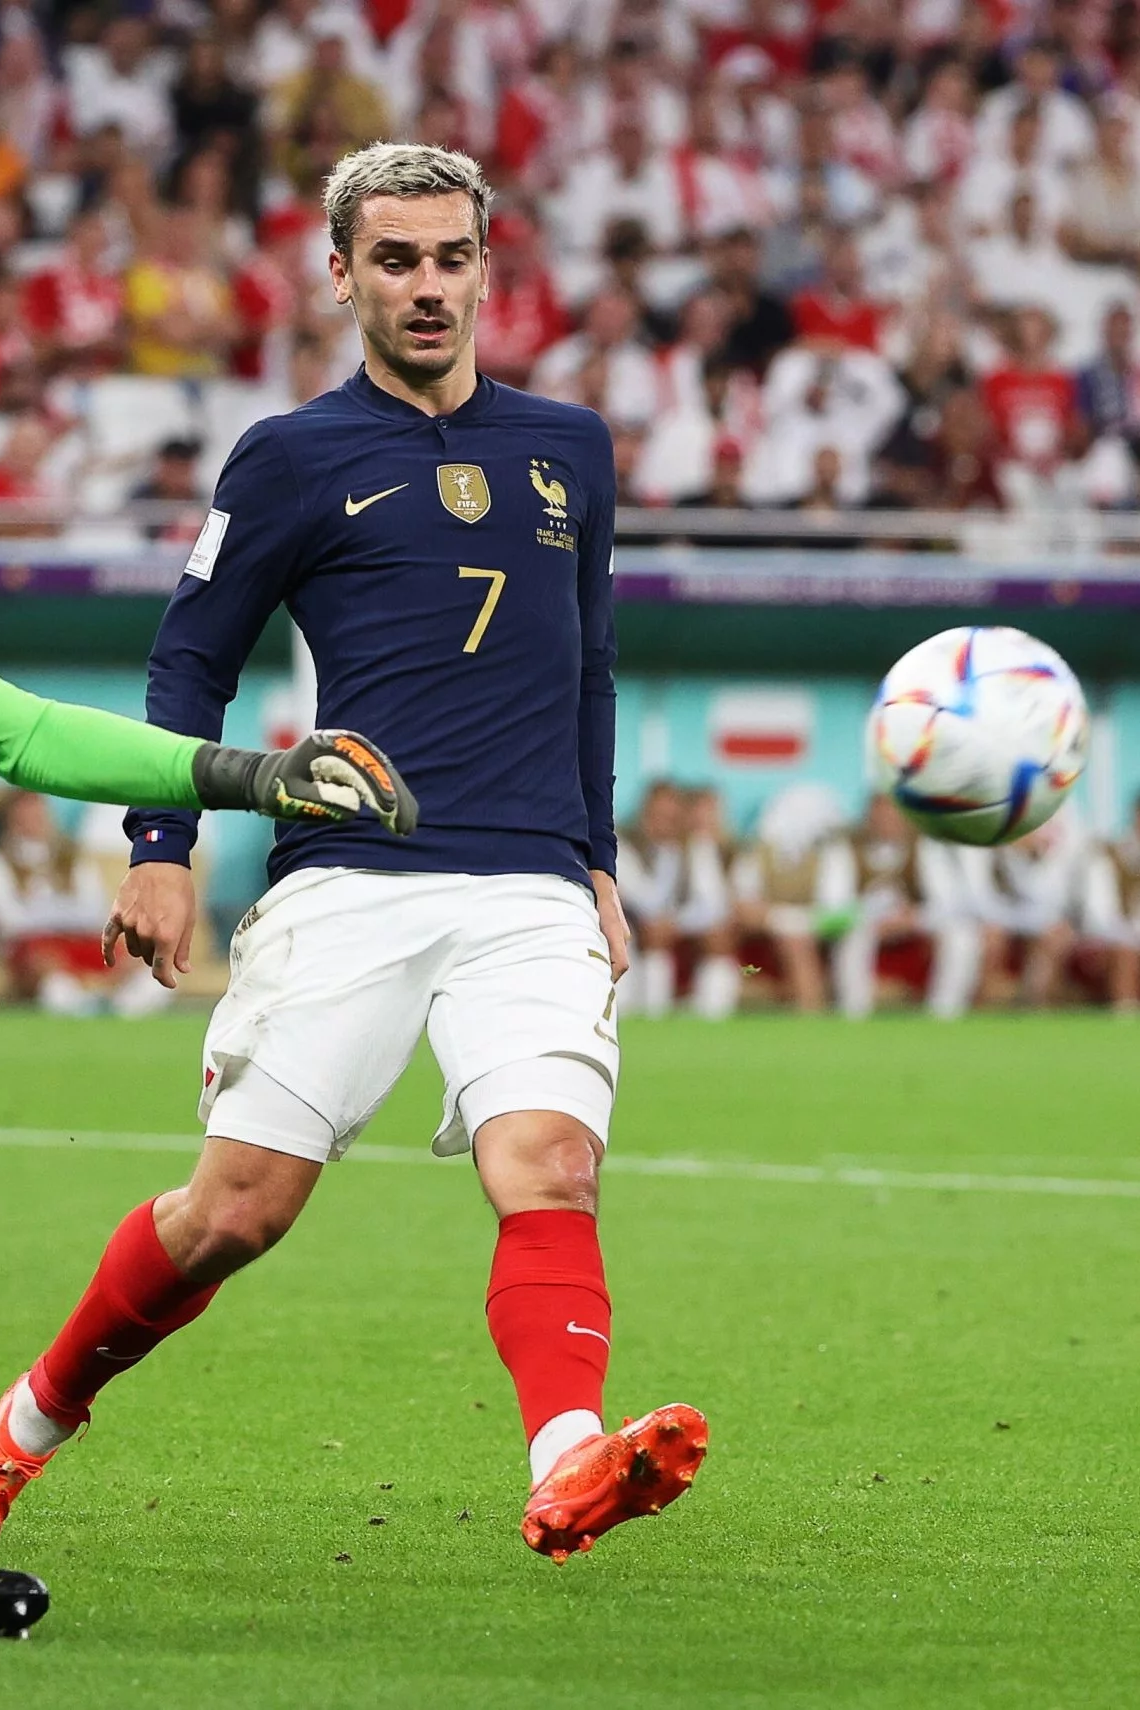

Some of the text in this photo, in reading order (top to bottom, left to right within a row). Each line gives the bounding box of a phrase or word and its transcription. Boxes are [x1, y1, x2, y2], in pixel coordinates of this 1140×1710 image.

[457, 500, 477, 508] FIFA
[536, 528, 555, 539] FRANCE
[458, 566, 507, 653] 7
